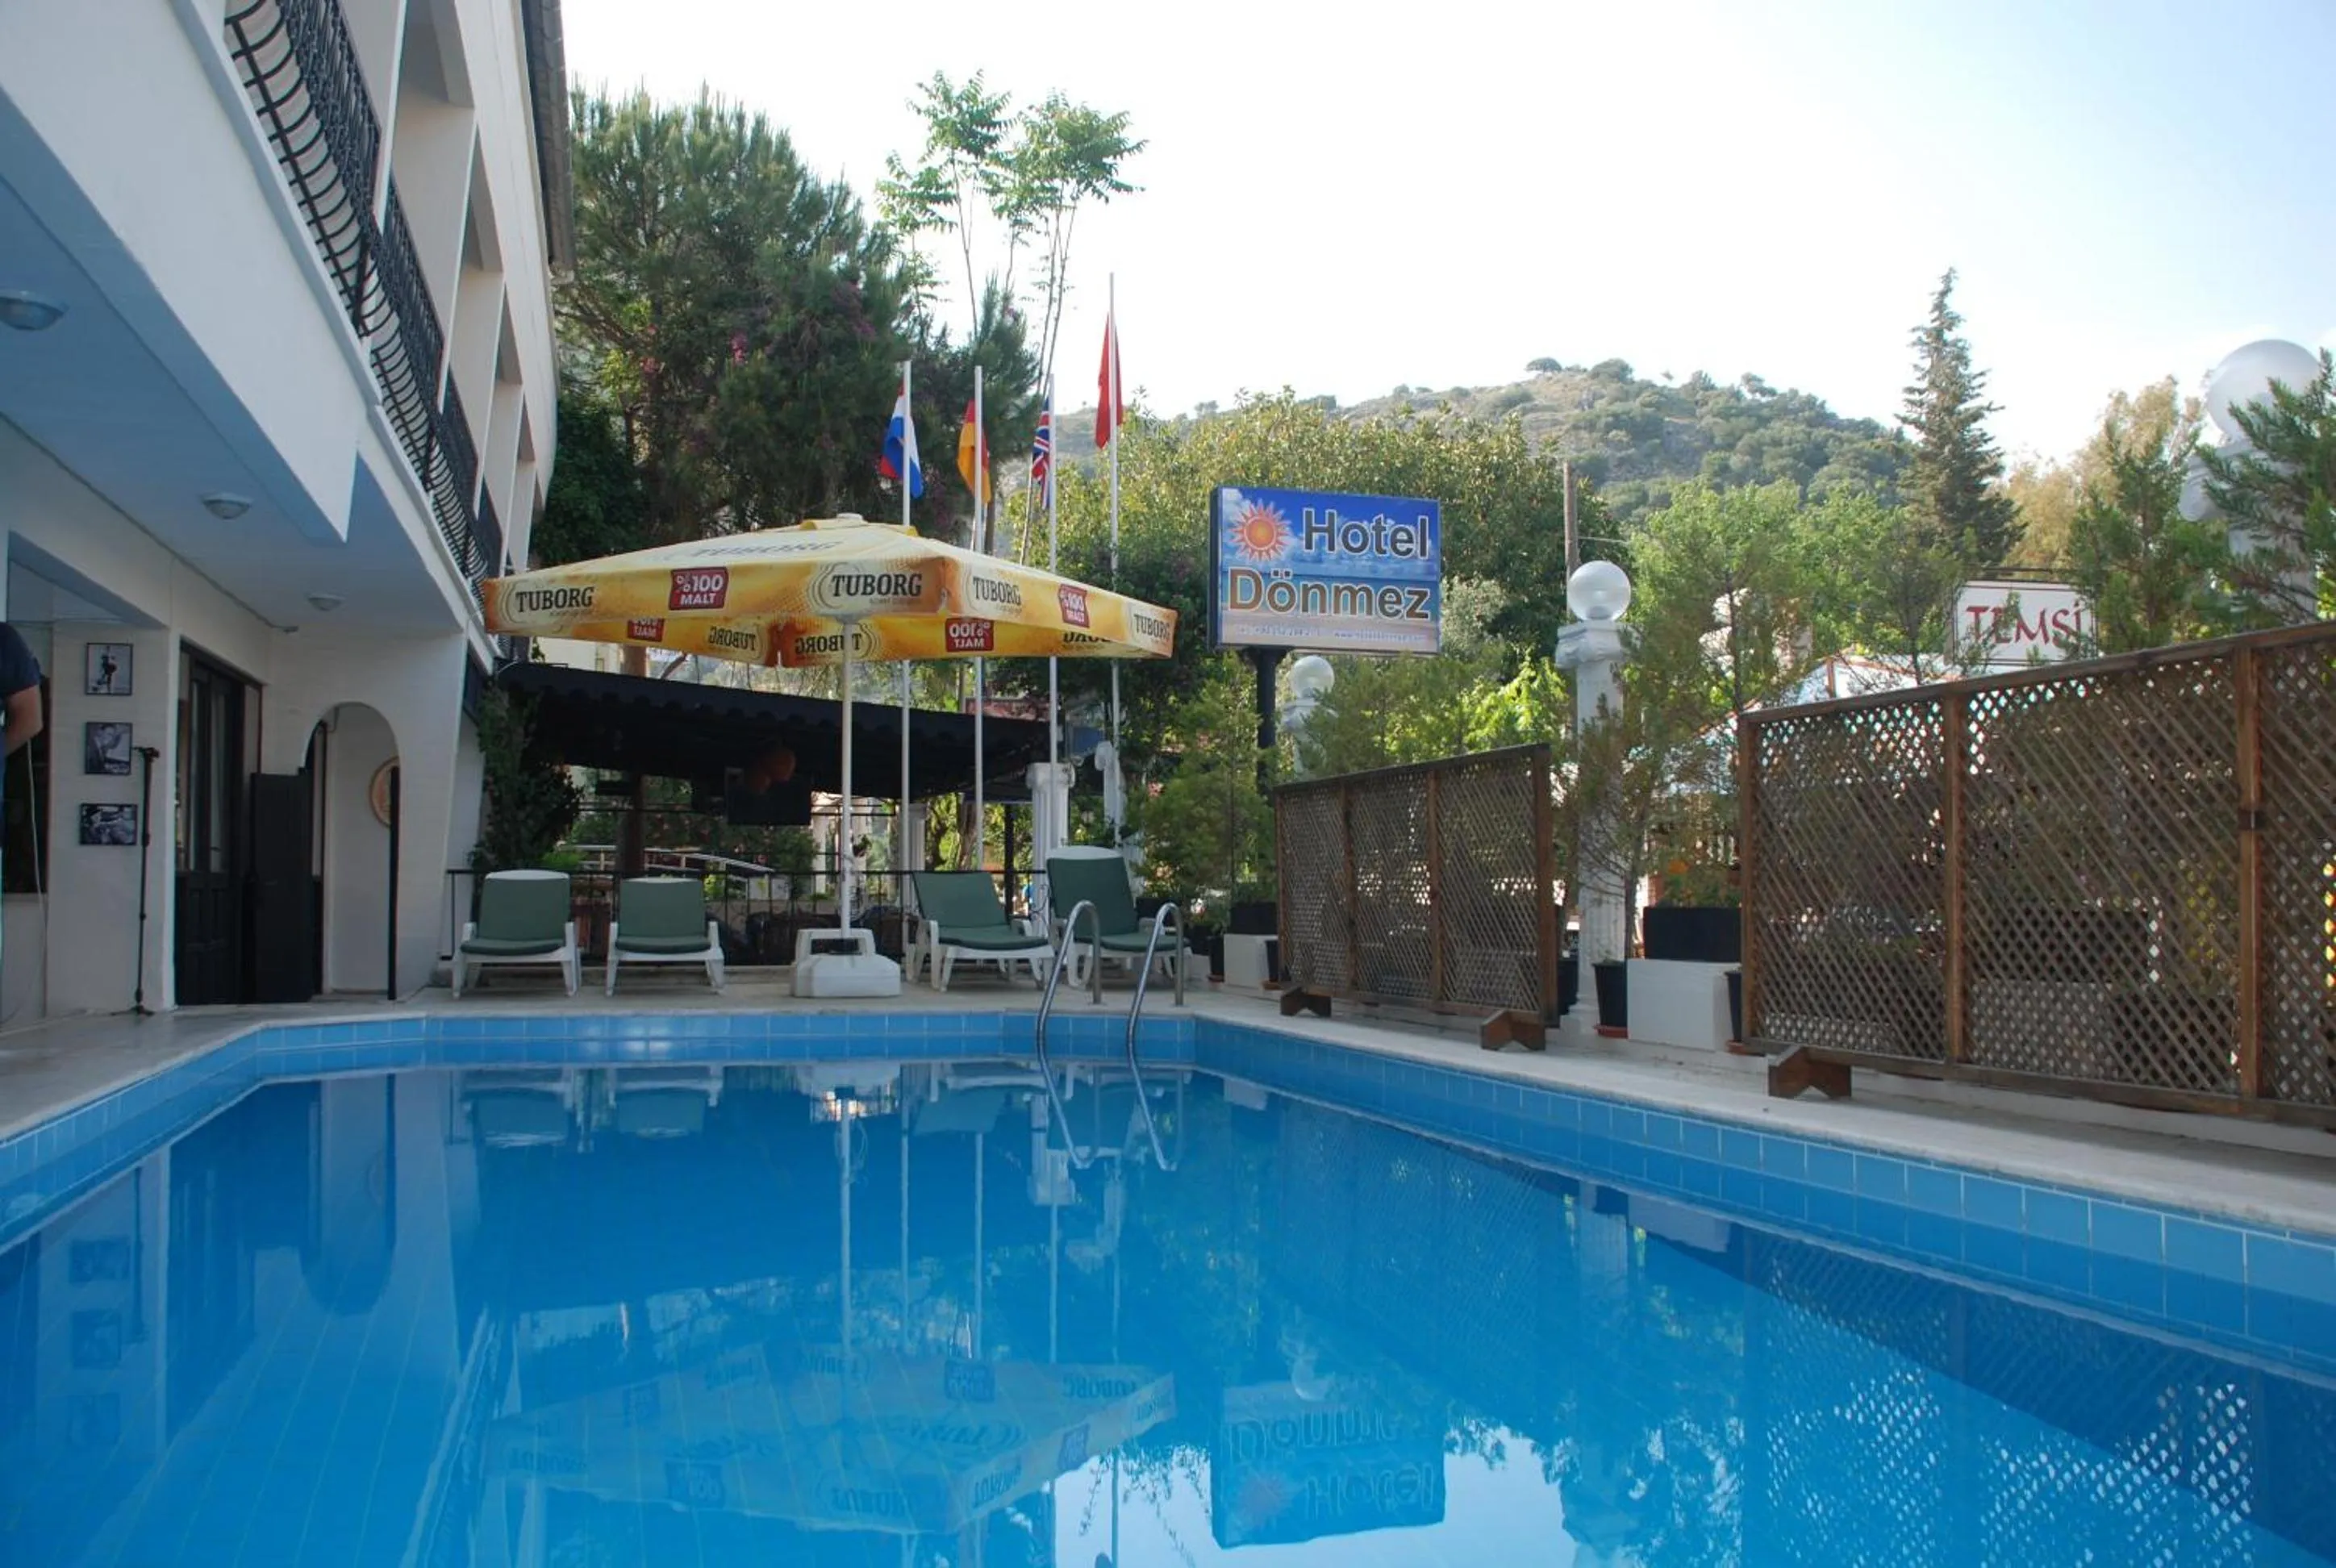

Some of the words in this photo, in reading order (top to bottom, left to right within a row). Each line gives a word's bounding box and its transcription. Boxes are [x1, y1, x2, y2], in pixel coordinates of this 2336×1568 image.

[1303, 507, 1429, 560] Hotel
[675, 573, 724, 594] %100
[831, 572, 923, 598] TUBORG
[973, 577, 1021, 607] TUBORG
[1228, 567, 1431, 620] Dönmez
[515, 586, 595, 613] TUBORG
[679, 593, 717, 606] MALT
[1133, 614, 1170, 640] TUBORG
